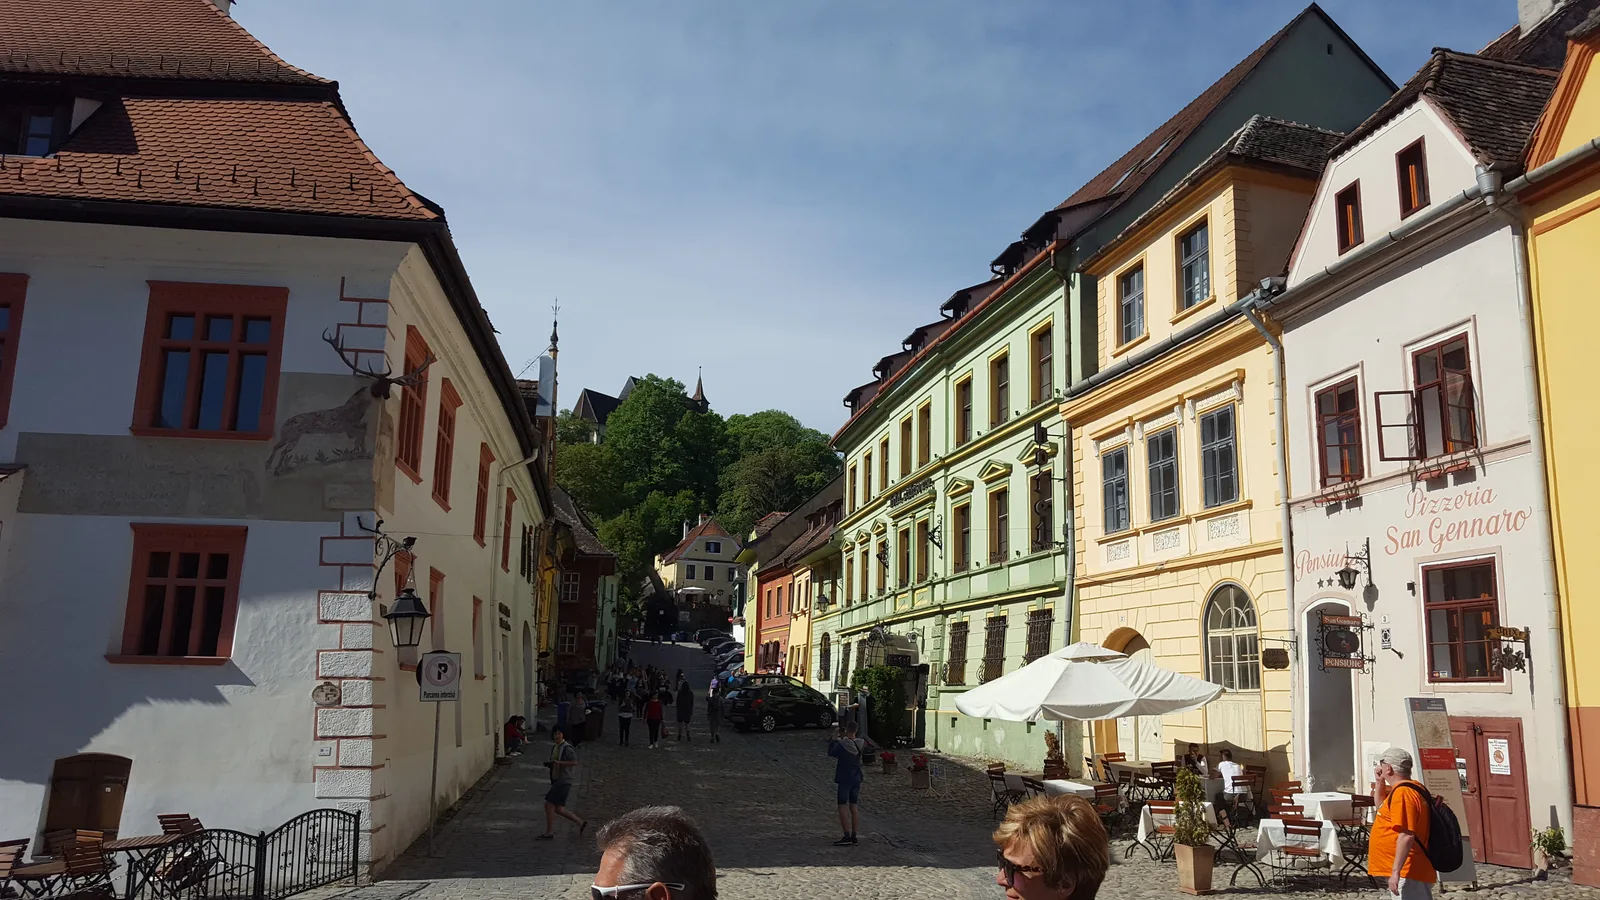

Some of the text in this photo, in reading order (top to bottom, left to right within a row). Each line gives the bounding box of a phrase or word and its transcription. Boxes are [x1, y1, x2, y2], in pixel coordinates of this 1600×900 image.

[1405, 486, 1497, 518] Pizzeria
[1385, 506, 1532, 555] San Gennaro
